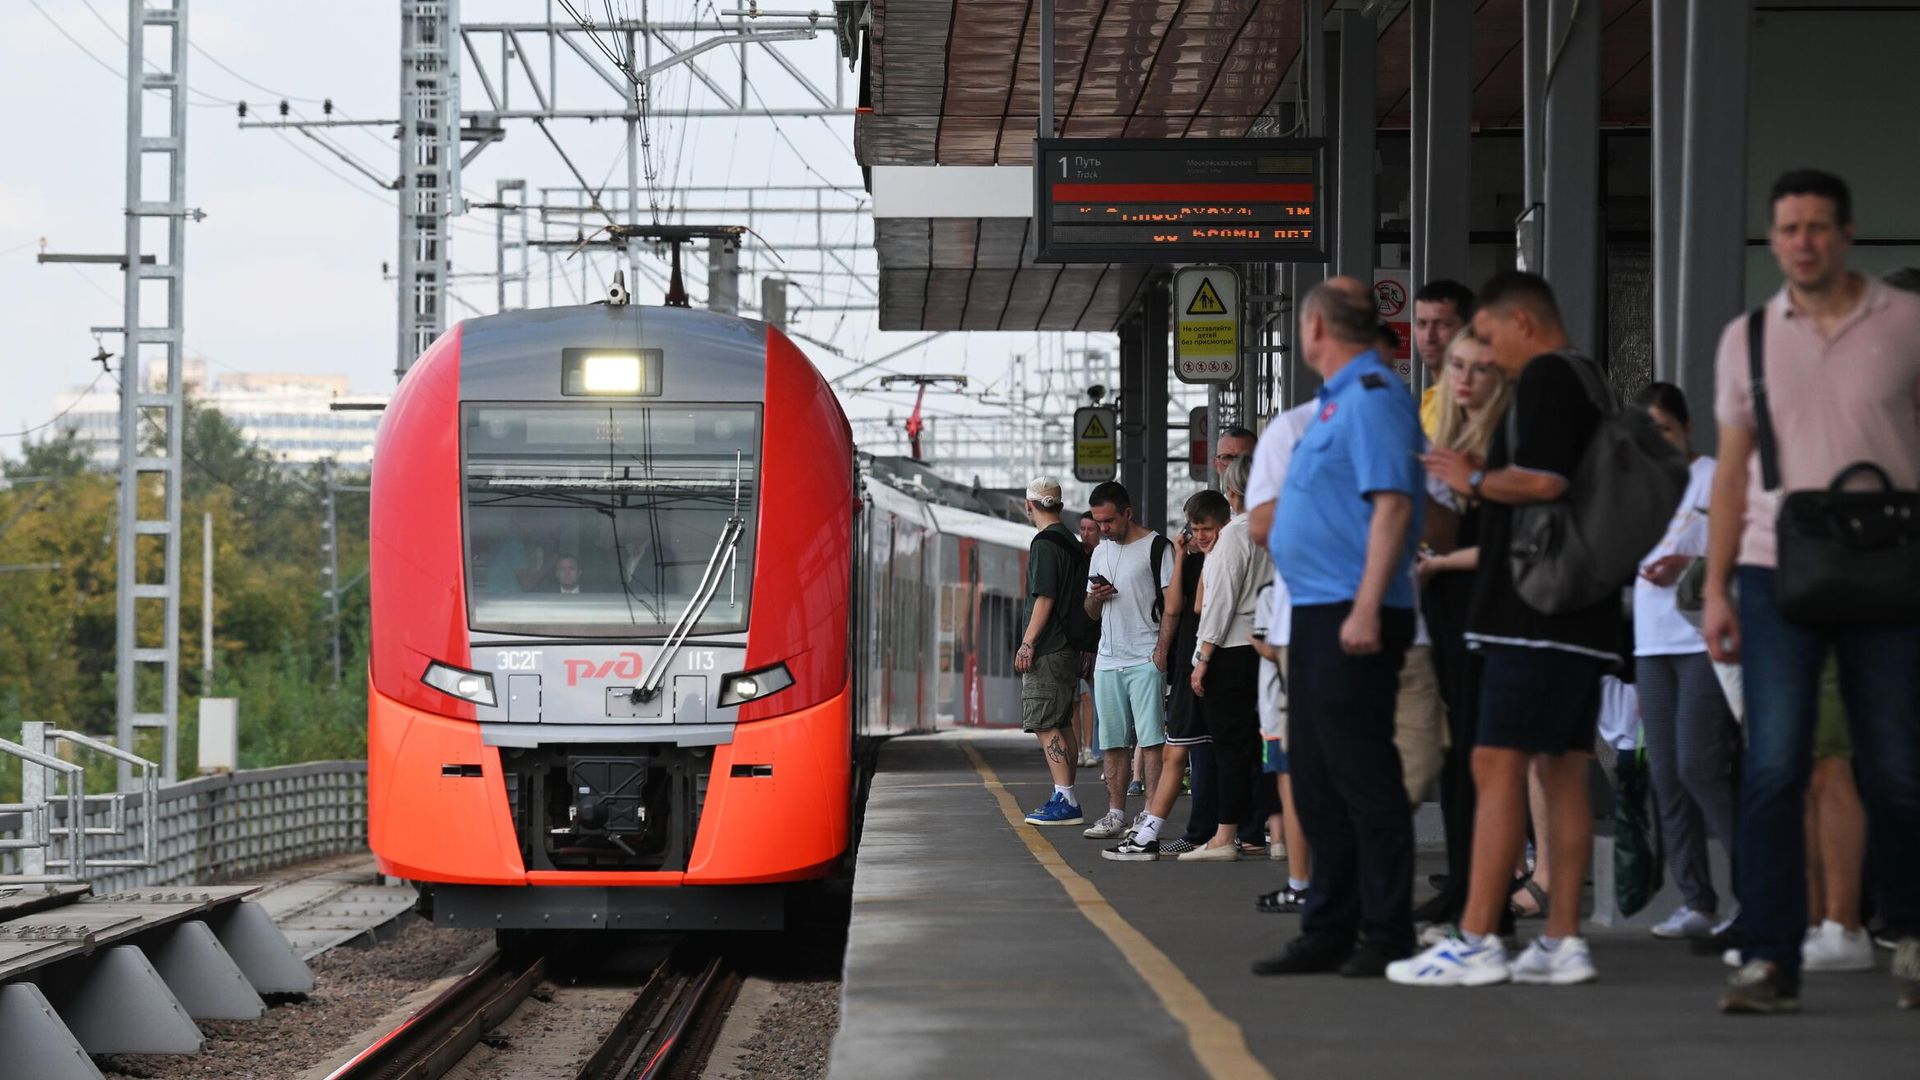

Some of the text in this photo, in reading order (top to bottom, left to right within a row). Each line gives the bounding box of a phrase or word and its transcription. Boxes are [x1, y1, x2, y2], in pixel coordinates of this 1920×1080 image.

[1058, 156, 1102, 178] 1 Путь
[1077, 170, 1098, 178] Track
[1193, 325, 1232, 333] оставляйте
[1181, 338, 1234, 346] без присмотра!
[497, 651, 714, 669] ЭС2Г 113
